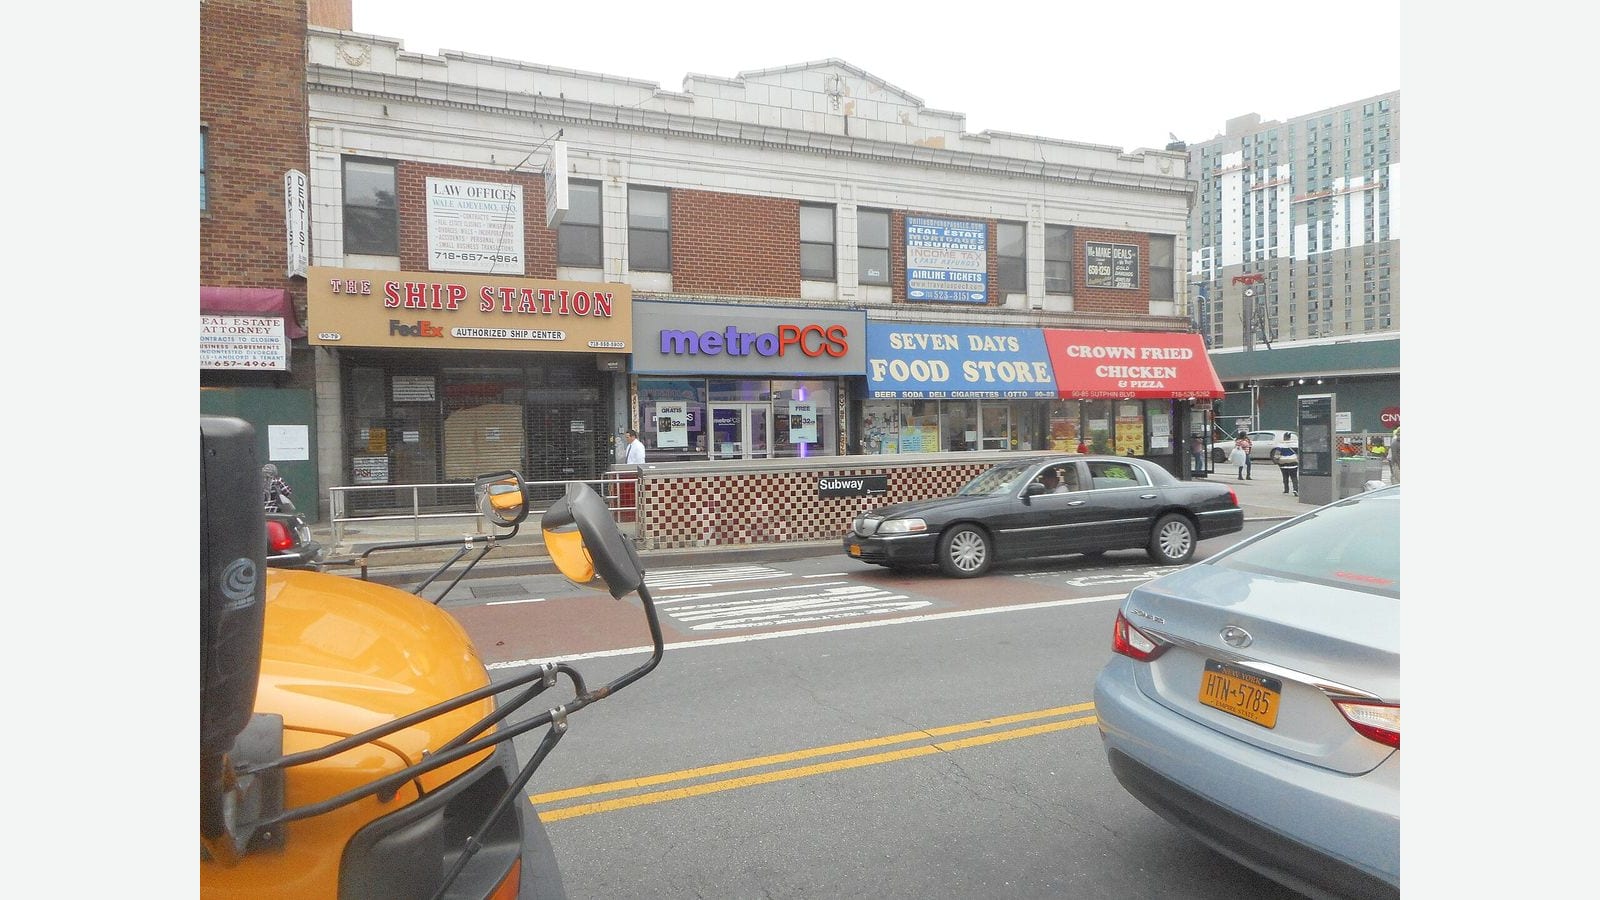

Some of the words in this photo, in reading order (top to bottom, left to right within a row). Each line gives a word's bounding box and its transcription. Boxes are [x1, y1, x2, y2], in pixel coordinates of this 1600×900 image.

[434, 184, 461, 196] LAW
[467, 187, 516, 200] OFFICES
[432, 199, 455, 208] WALE
[909, 227, 939, 235] REAL
[943, 229, 985, 239] ESTATE
[909, 234, 985, 245] MORTGAGES
[909, 240, 985, 250] INSURANCE
[434, 252, 518, 263] 718-657-4964
[911, 249, 956, 259] INCOME
[960, 252, 982, 260] TAX
[1095, 246, 1111, 258] MAKE
[1113, 248, 1132, 259] DEALS
[912, 270, 946, 280] AIRLINE
[949, 272, 982, 282] TICKETS
[330, 279, 371, 295] THE
[384, 280, 468, 310] SHIP
[479, 285, 614, 317] STATION
[234, 319, 281, 327] ESTATE
[203, 326, 272, 334] ATTORNEY
[390, 319, 444, 338] FedEx
[456, 329, 507, 338] AUTHORIZED
[510, 330, 528, 338] SHIP
[532, 331, 562, 340] CENTER
[660, 324, 848, 358] metroPCS
[890, 333, 959, 350] SEVEN
[968, 335, 1020, 352] DAYS
[1067, 345, 1137, 360] CROWN
[1141, 347, 1193, 360] FRIED
[870, 359, 950, 382] FOOD
[962, 360, 1051, 383] STORE
[1095, 365, 1177, 379] CHICKEN
[1119, 380, 1127, 388] &
[661, 406, 682, 414] GRATIS
[819, 479, 864, 490] Subway
[1206, 674, 1231, 701] HTN
[1237, 684, 1271, 715] 5785
